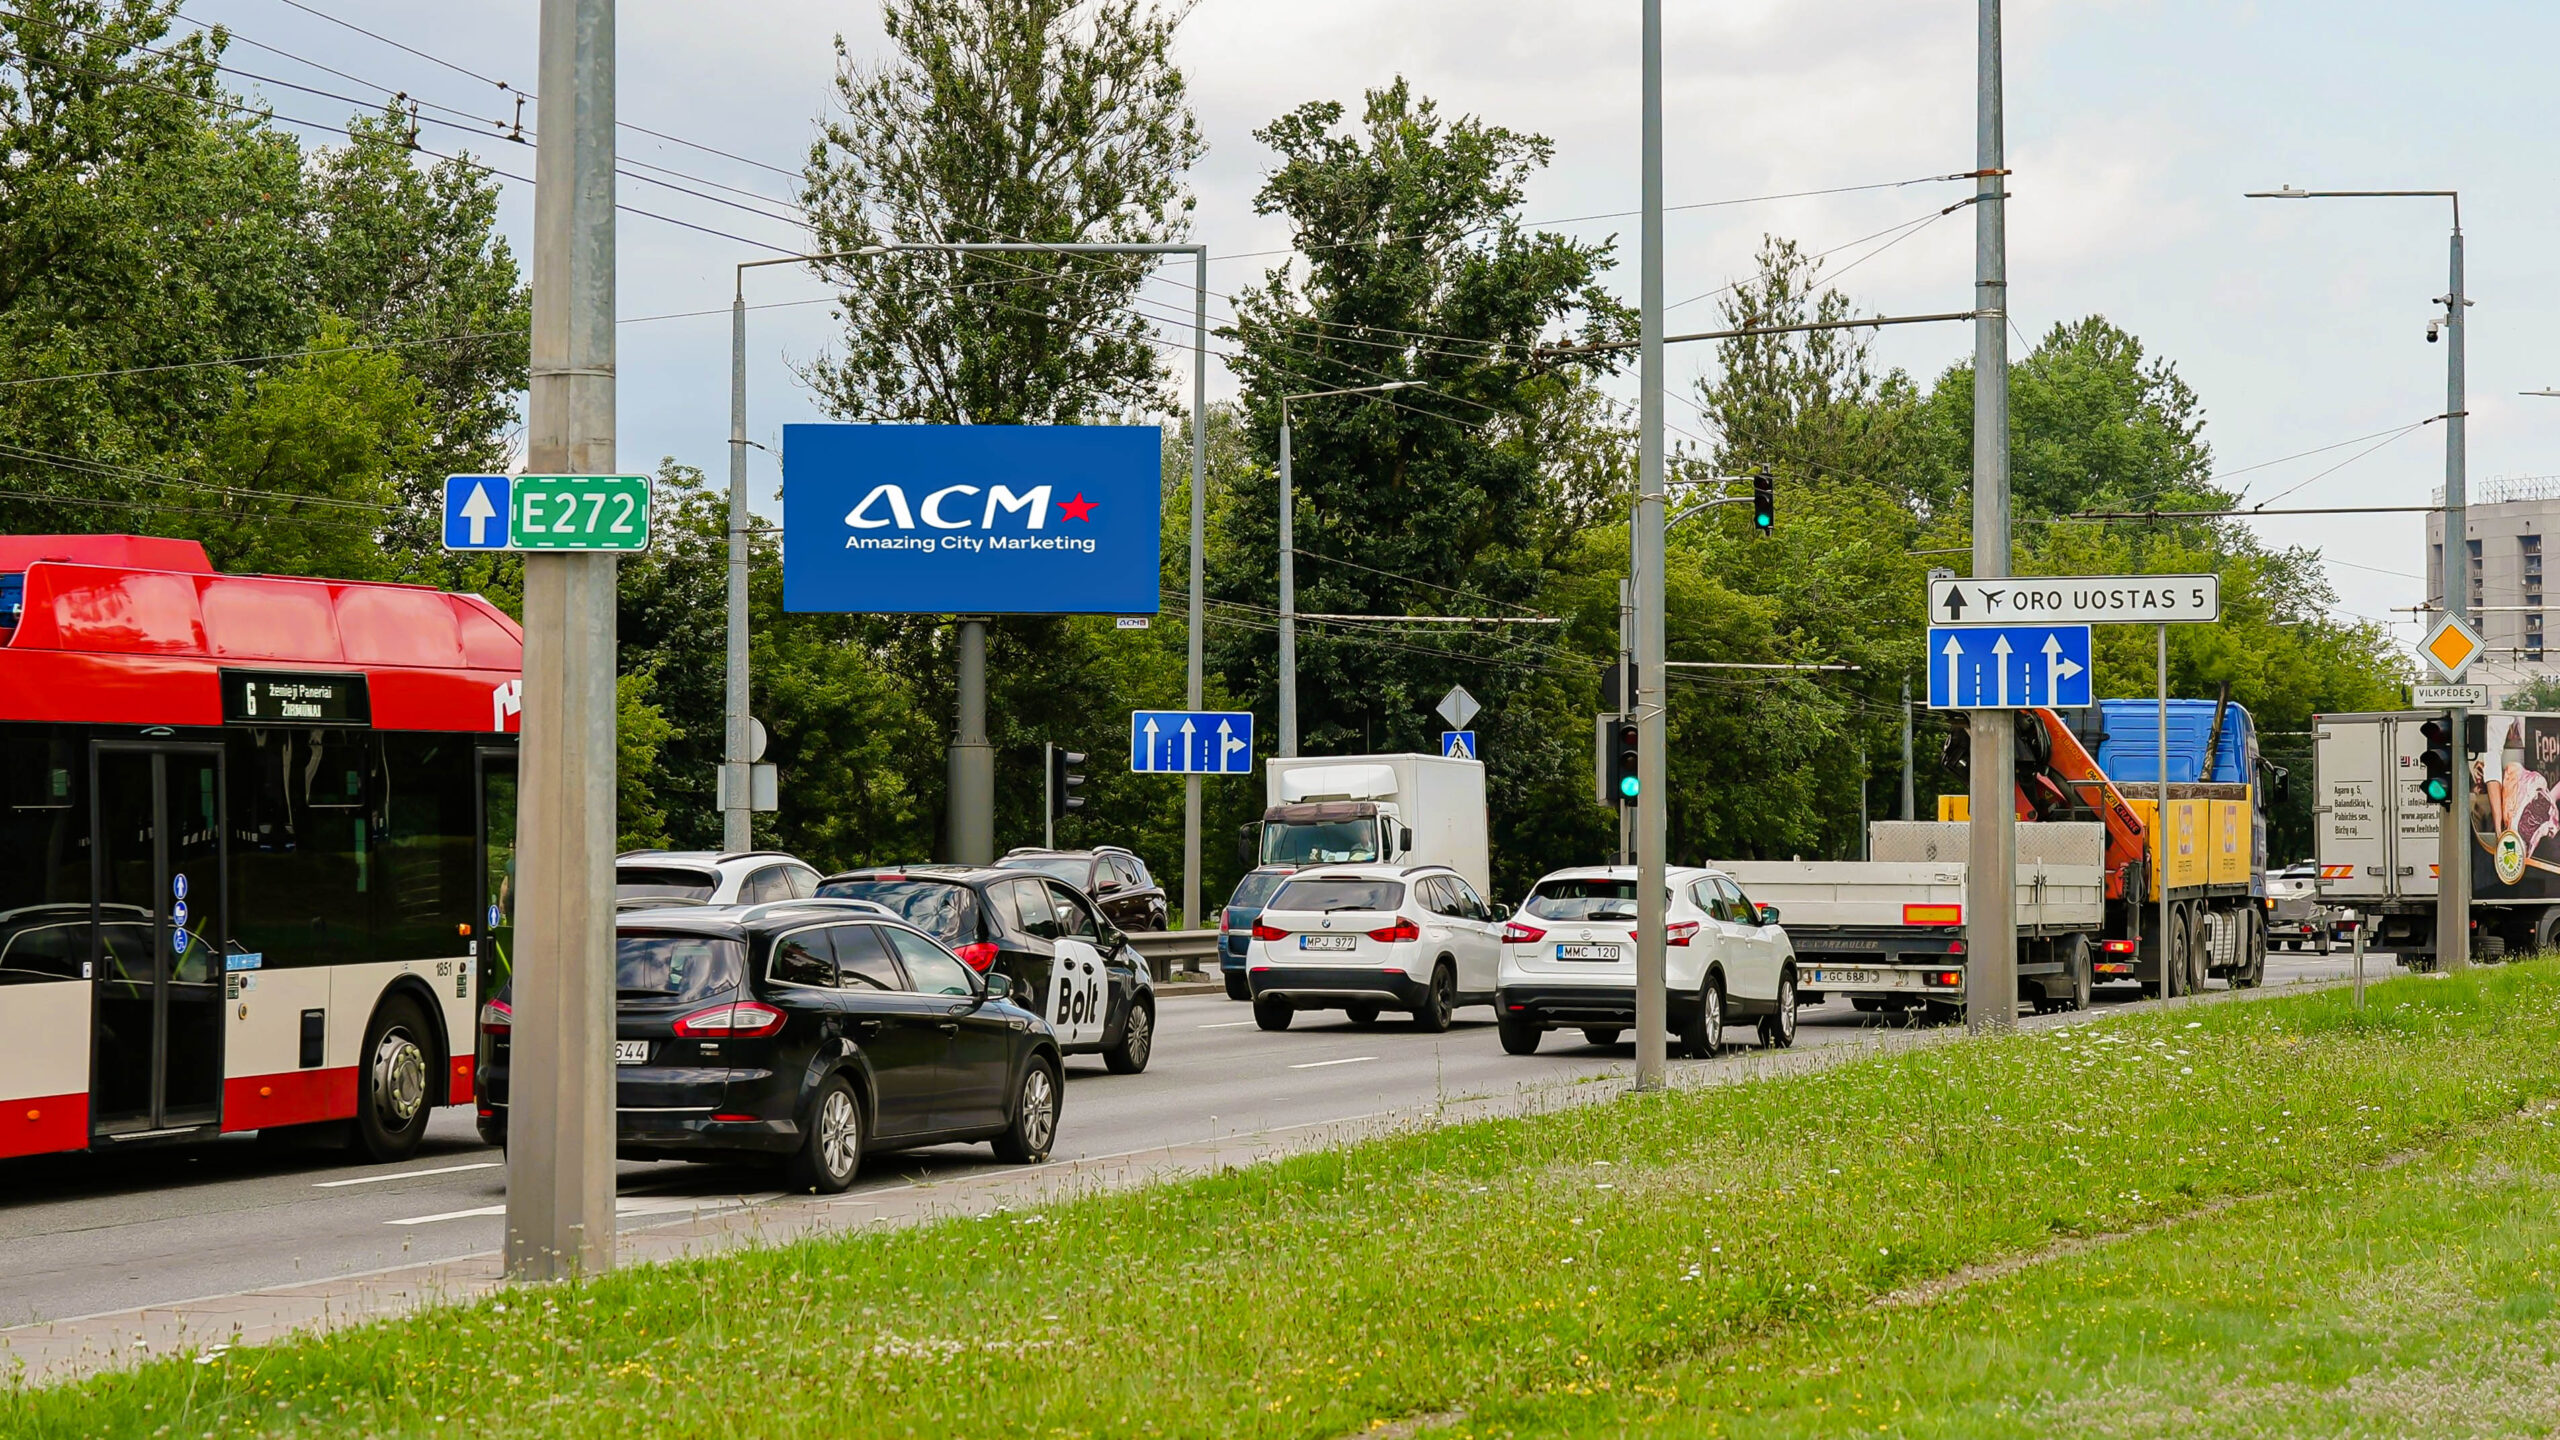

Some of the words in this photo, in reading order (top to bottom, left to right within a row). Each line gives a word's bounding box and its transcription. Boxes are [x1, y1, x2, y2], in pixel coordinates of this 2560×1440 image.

[522, 492, 635, 534] E272
[844, 484, 1052, 530] ACM
[845, 535, 936, 553] Amazing
[940, 535, 984, 553] City
[989, 535, 1096, 553] Marketing
[2013, 591, 2062, 611] ORO
[2074, 589, 2176, 610] UOSTAS
[2192, 588, 2205, 608] 5
[246, 682, 257, 716] 6
[2419, 687, 2472, 697] VILKPĖDĖS
[1306, 937, 1329, 947] MPJ
[1335, 937, 1354, 947] 977
[1564, 947, 1588, 958] MMC
[1597, 947, 1617, 958] 120
[435, 962, 453, 977] 1851
[1056, 977, 1099, 1025] Bolt
